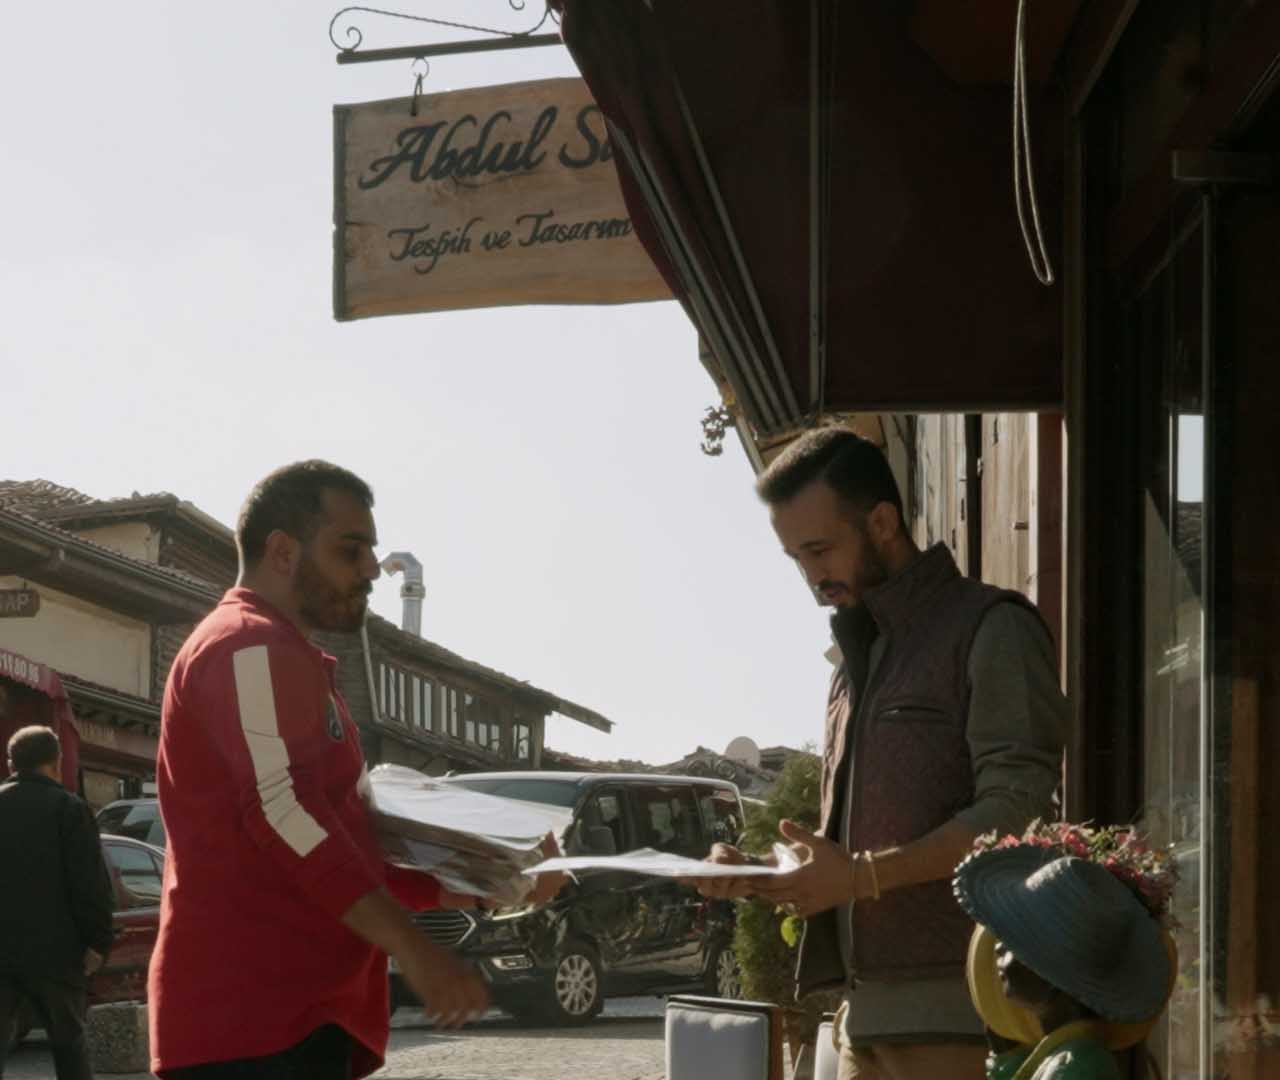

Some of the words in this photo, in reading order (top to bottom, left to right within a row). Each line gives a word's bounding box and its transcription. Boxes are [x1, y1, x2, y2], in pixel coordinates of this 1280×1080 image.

[358, 106, 558, 190] Abdul
[387, 217, 482, 274] Tespih
[480, 229, 511, 250] ve
